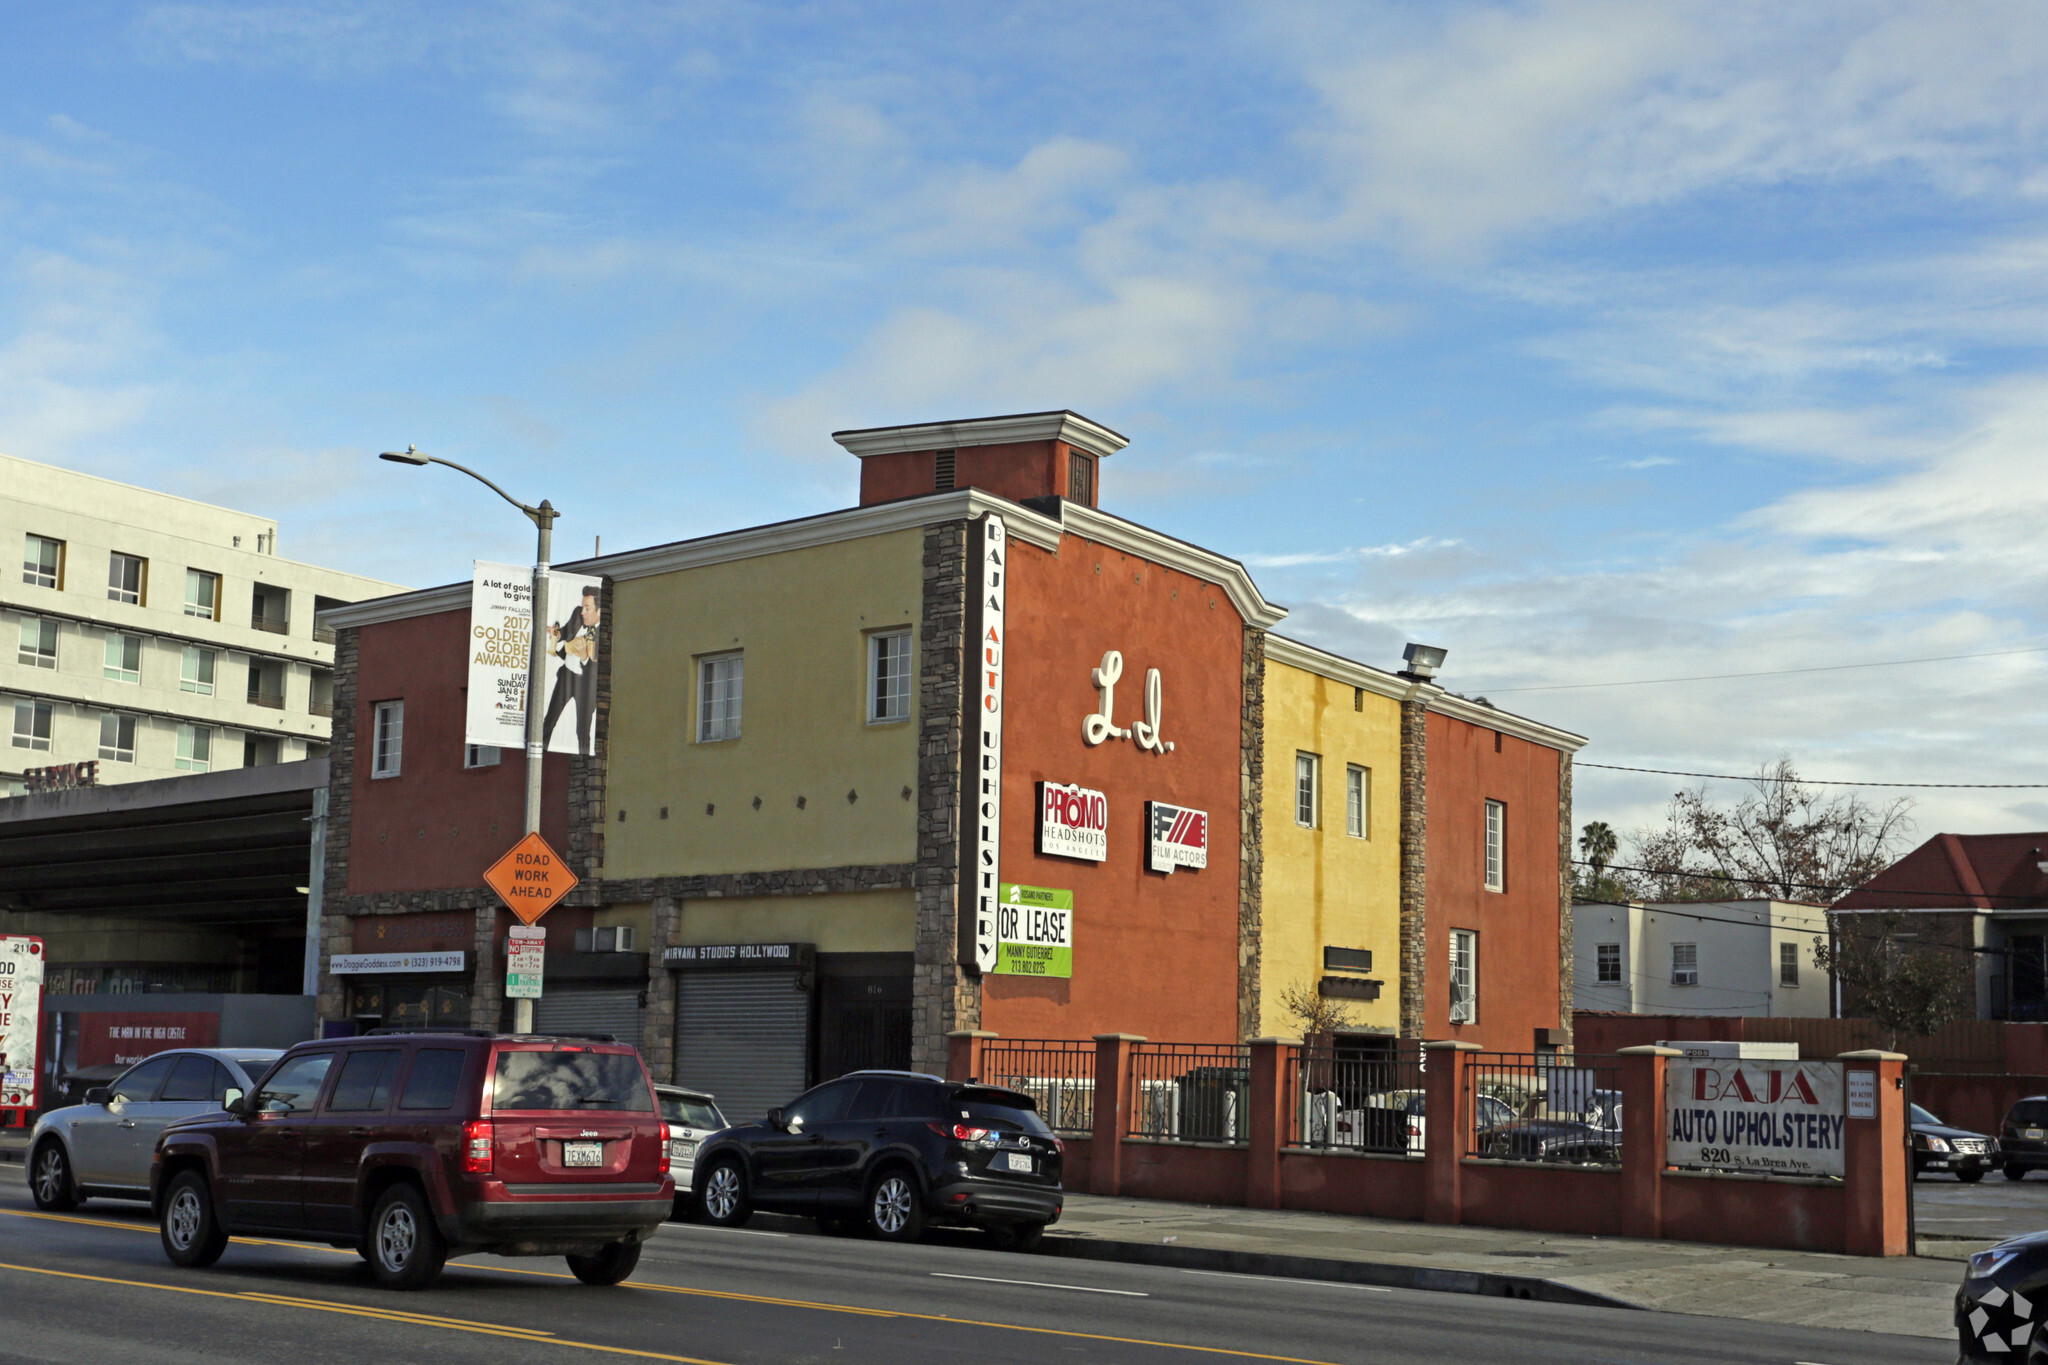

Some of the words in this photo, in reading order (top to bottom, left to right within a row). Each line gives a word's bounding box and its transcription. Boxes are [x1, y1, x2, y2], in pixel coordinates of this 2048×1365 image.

[985, 523, 1002, 612] BAJA
[491, 580, 501, 588] lot
[513, 585, 530, 593] gold
[513, 593, 530, 601] give
[504, 616, 530, 629] 2017
[473, 625, 530, 643] GOLDEN
[485, 640, 529, 657] GLOBE
[474, 652, 528, 670] AWARDS
[511, 673, 527, 681] LIVE
[985, 625, 1000, 714] AUTO
[497, 679, 526, 688] SUNDAY
[23, 761, 99, 789] SERVICE
[1045, 787, 1105, 831] PROMO
[1044, 826, 1105, 847] HEADSHOTS
[978, 731, 998, 960] UPHOLSTERY
[1043, 841, 1060, 849] LOS
[1066, 845, 1105, 857] ANGELES
[516, 853, 550, 866] ROAD
[1152, 845, 1171, 858] FILM
[1173, 849, 1206, 865] ACTORS
[515, 869, 549, 882] WORK
[509, 886, 552, 898] AHEAD
[999, 907, 1018, 940] OR
[1026, 909, 1066, 943] LEASE
[13, 943, 30, 953] 211
[510, 945, 519, 953] NO
[664, 947, 696, 960] NIRVANA
[700, 945, 736, 959] STUDIOS
[740, 945, 790, 958] HOLLYWOOD
[1006, 945, 1026, 957] MANNY
[1026, 946, 1053, 960] GUTIERREZ
[331, 958, 401, 972] www.DoggieGoddess.com
[411, 958, 428, 969] (323)
[430, 956, 461, 967] 919-4798
[109, 1027, 120, 1038] THE
[121, 1027, 133, 1038] MAN
[134, 1027, 140, 1038] IN
[142, 1027, 152, 1038] THE
[153, 1027, 165, 1039] HIGH
[167, 1027, 186, 1039] CASTLE
[115, 1054, 125, 1064] Our
[1691, 1067, 1819, 1105] BAJA
[1672, 1108, 1717, 1144] AUTO
[1723, 1110, 1844, 1150] UPHOLSTERY
[566, 1150, 601, 1163] 7EXM676
[1701, 1148, 1730, 1164] 820
[1734, 1155, 1744, 1165] S.
[1746, 1156, 1760, 1166] La
[1762, 1157, 1787, 1168] Brea
[1788, 1159, 1811, 1170] Ave.
